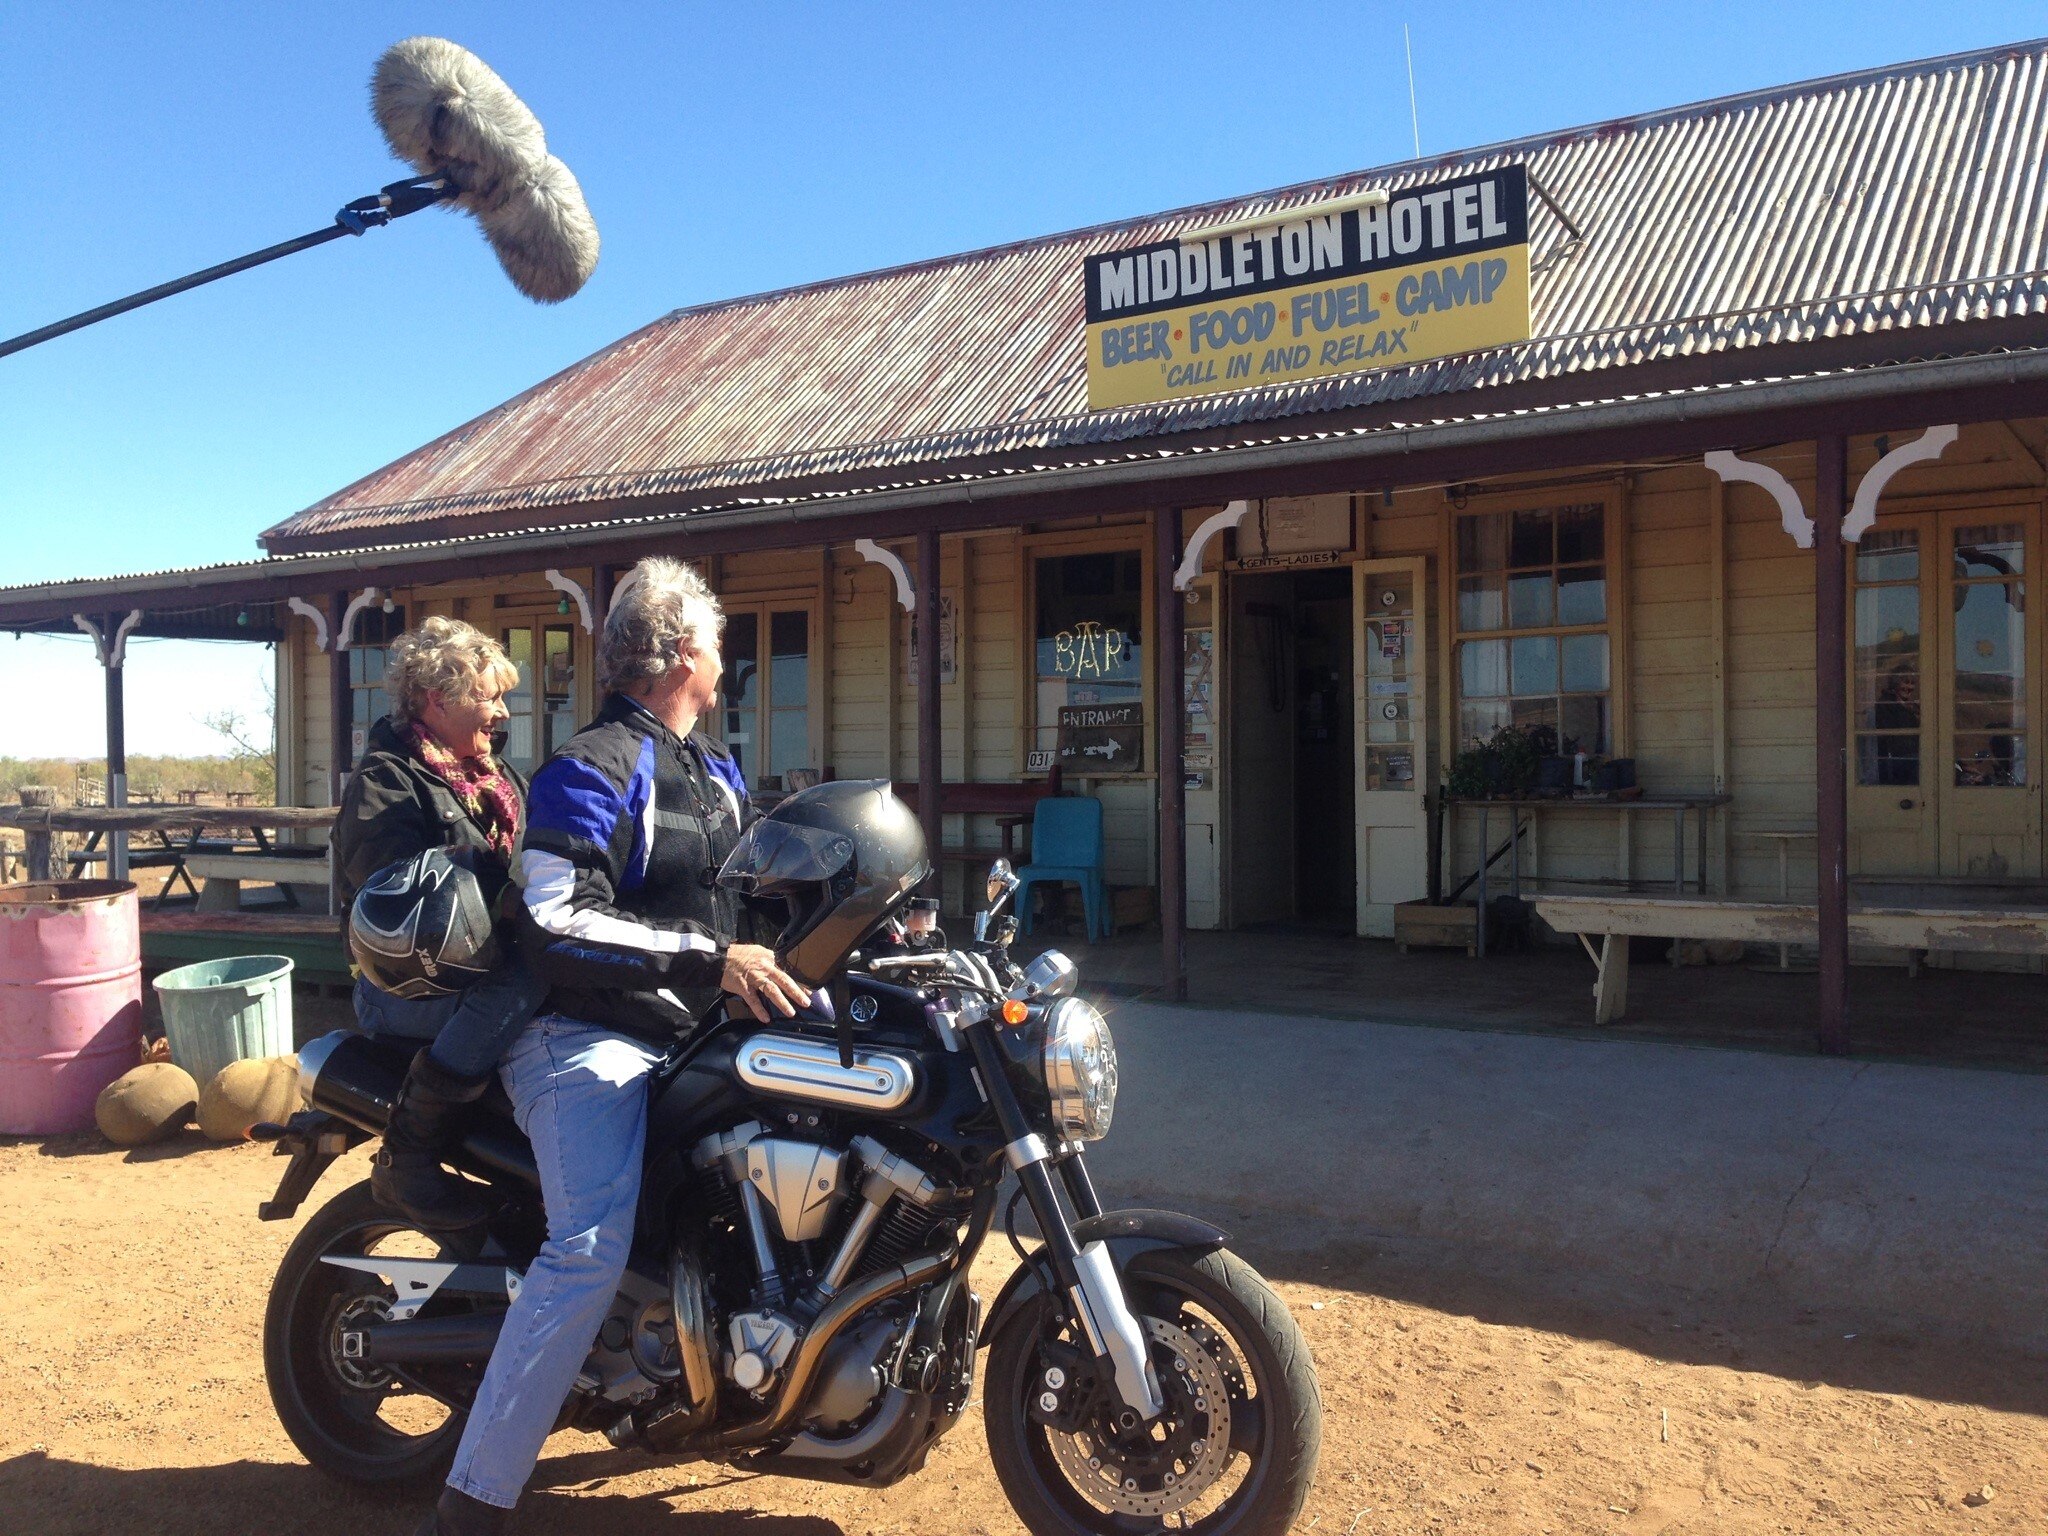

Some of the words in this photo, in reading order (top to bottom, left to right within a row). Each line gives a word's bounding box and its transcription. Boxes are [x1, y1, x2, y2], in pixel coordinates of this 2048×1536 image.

[1099, 213, 1343, 311] MIDDLETON
[1358, 180, 1507, 262] HOTEL
[1101, 320, 1172, 368] BEER
[1189, 301, 1276, 354] FOOD
[1291, 282, 1380, 337] FUEL
[1396, 258, 1508, 316] CAMP
[1226, 352, 1252, 379] IN
[1259, 344, 1311, 374] AND
[1055, 620, 1122, 678] BAR
